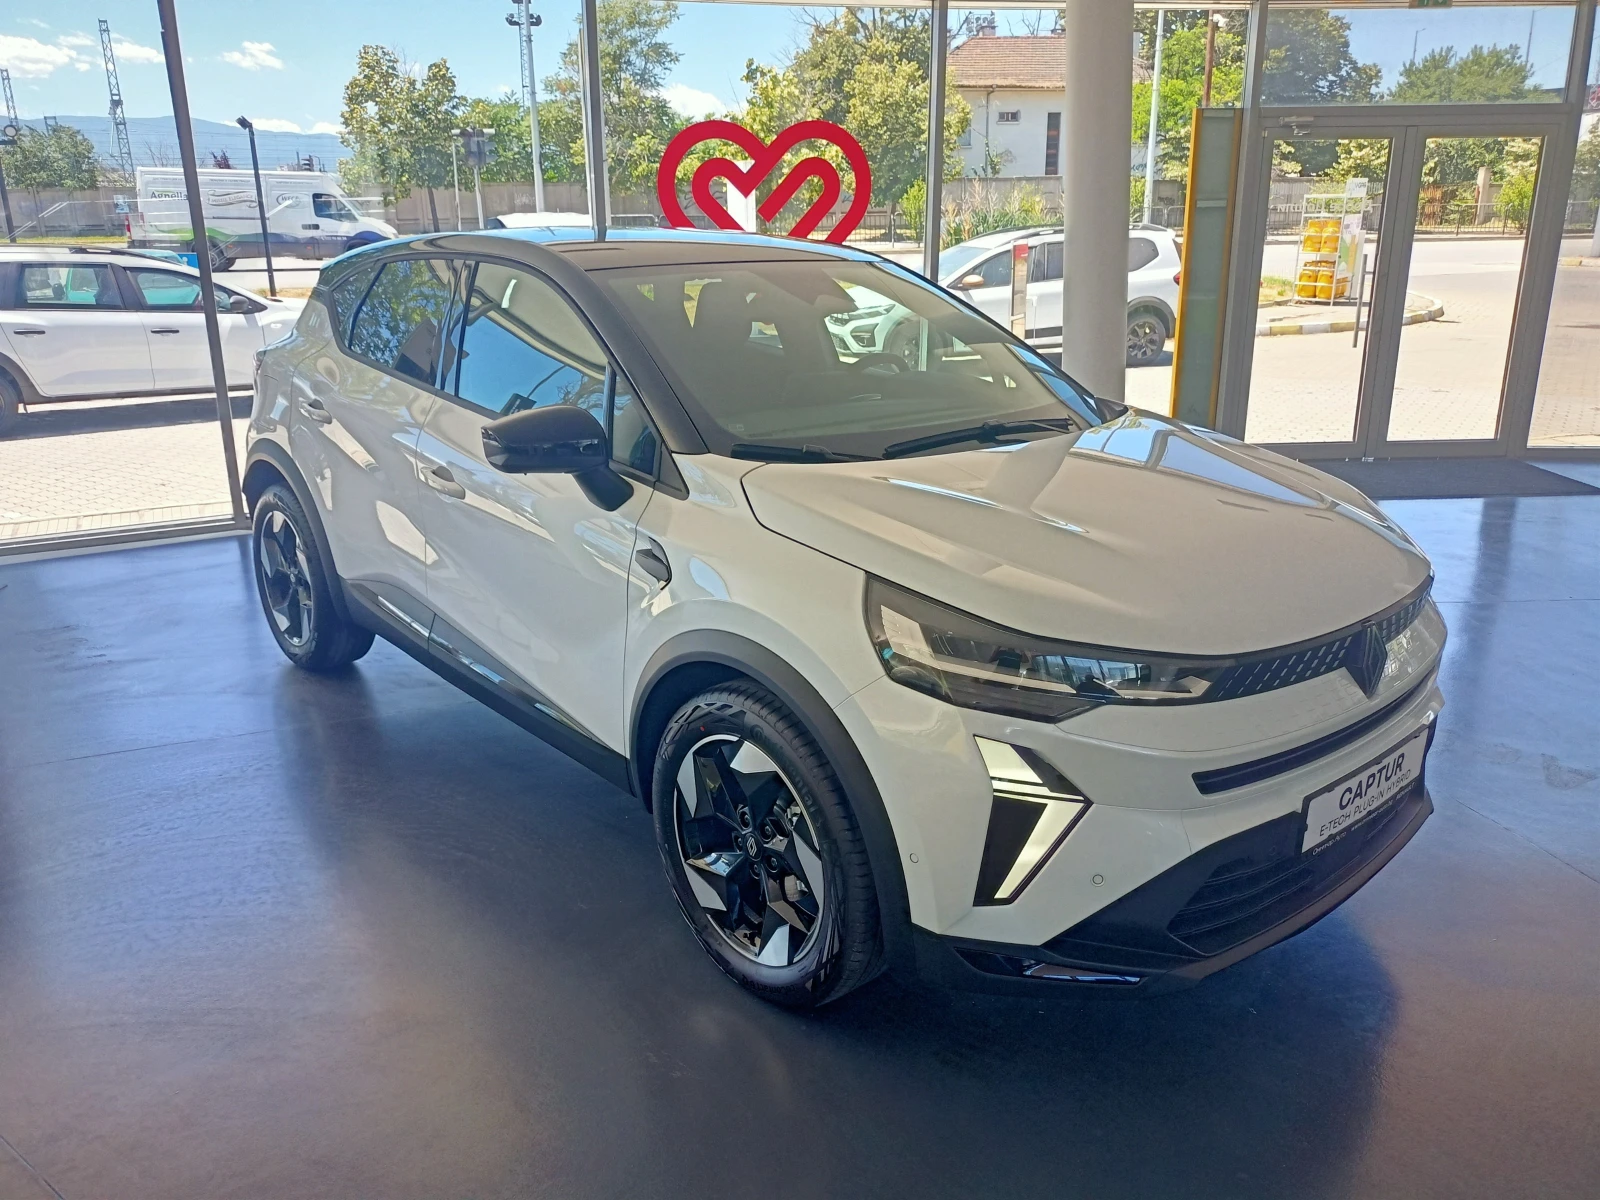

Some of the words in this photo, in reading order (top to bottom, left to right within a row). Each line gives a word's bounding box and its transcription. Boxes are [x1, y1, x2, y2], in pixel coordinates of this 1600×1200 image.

[1319, 811, 1351, 837] E-TECH
[1353, 788, 1385, 818] PLUG-IN
[1386, 769, 1412, 796] HYBRID
[1338, 752, 1405, 811] CAPTUR
